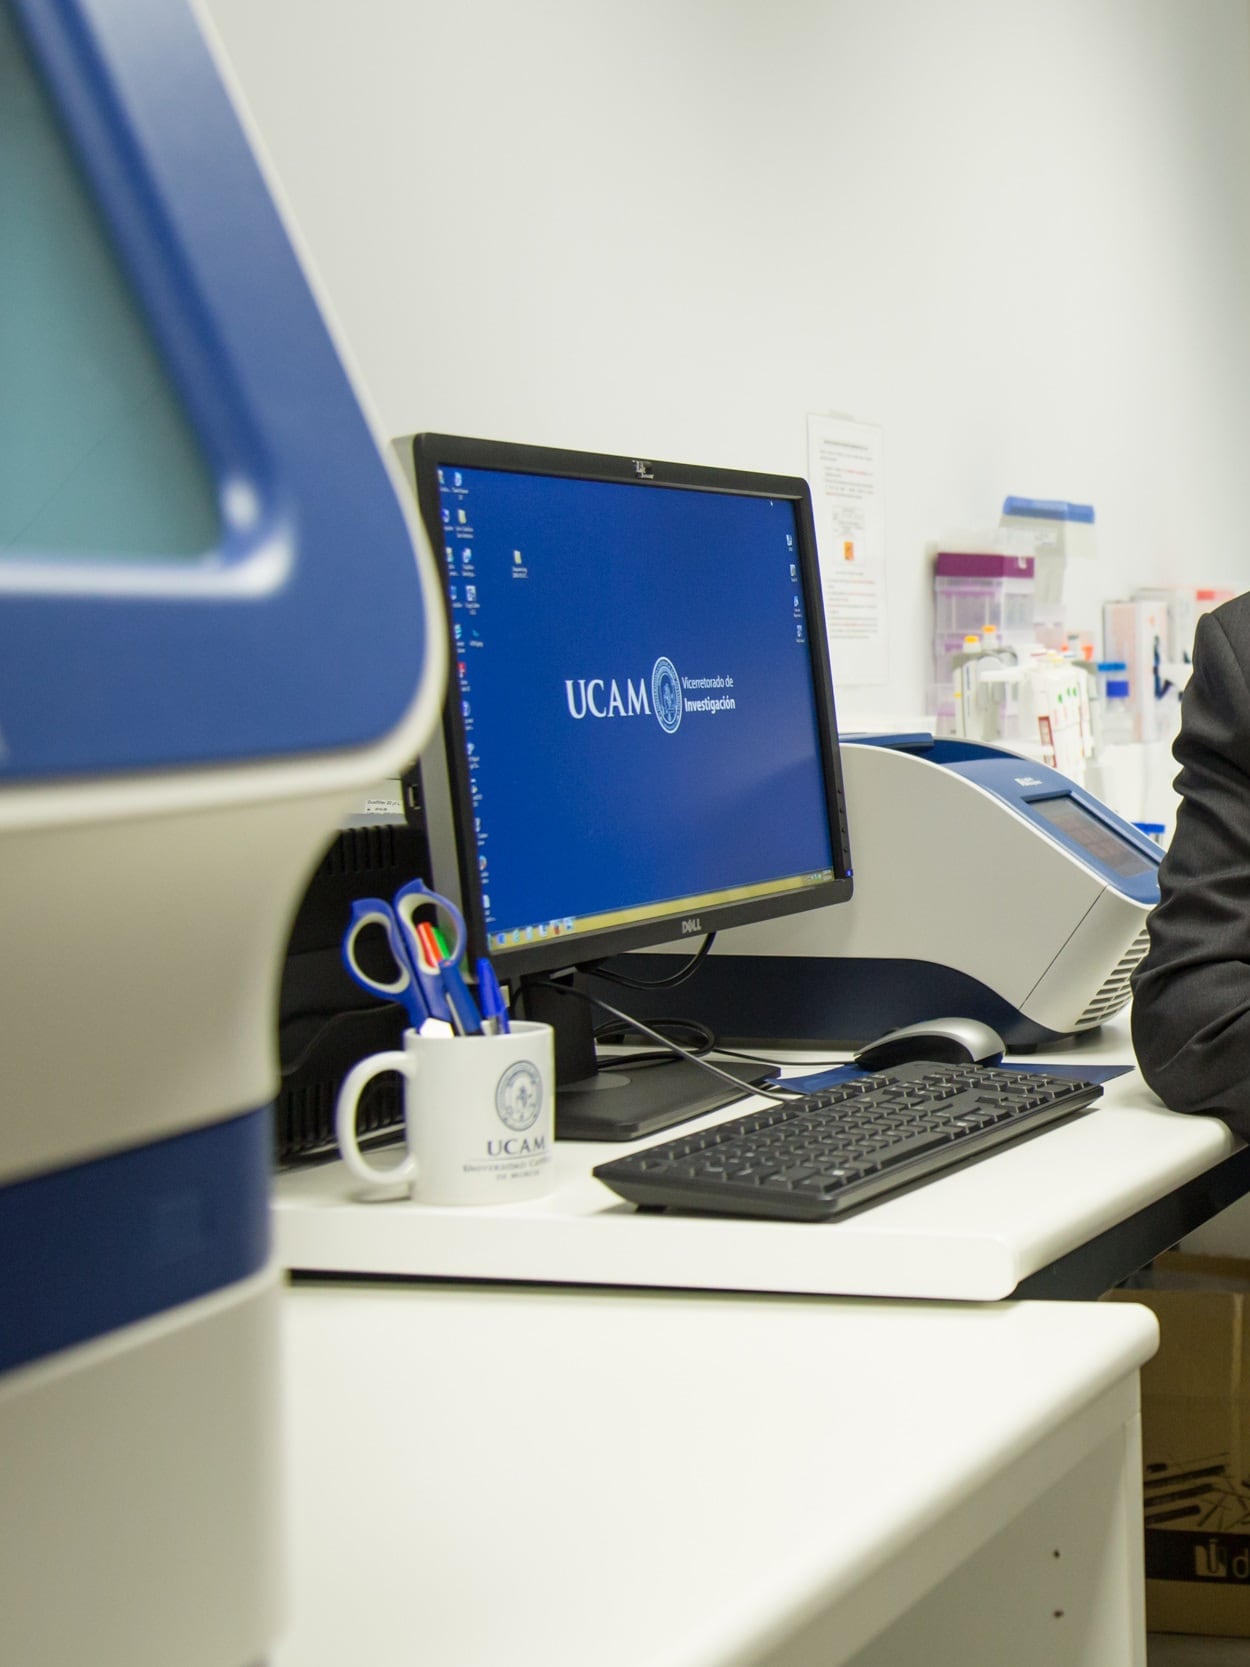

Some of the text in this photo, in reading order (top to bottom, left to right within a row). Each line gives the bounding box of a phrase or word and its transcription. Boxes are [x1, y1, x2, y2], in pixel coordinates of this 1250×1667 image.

[725, 674, 734, 688] de
[565, 678, 651, 719] UCAM
[684, 695, 736, 714] Investigación
[681, 918, 702, 934] DELL
[487, 1135, 546, 1156] UCAM
